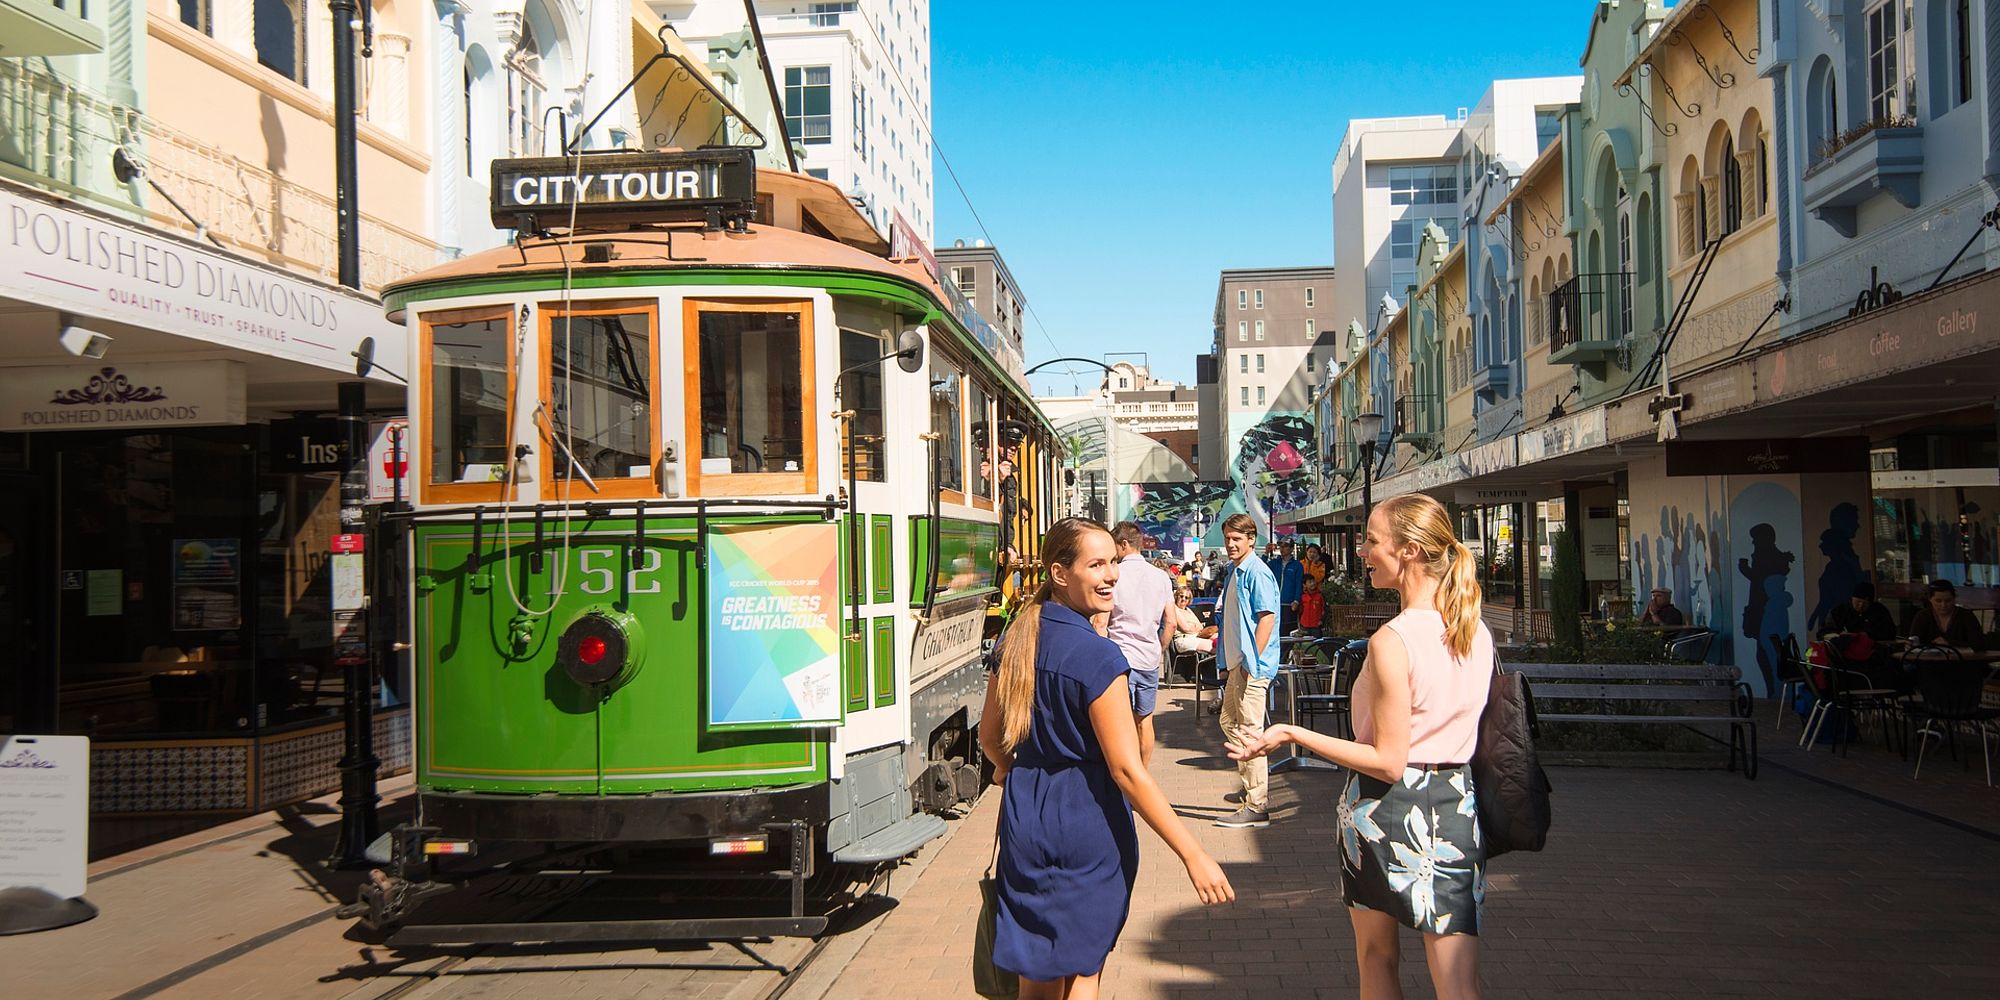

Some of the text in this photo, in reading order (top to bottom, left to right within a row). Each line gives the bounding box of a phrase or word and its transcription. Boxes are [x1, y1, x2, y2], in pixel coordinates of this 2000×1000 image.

[513, 174, 595, 206] CITY
[599, 170, 700, 202] TOUR
[11, 204, 338, 331] POLISHED DIAMONDS
[109, 288, 287, 343] QUALITY TRUST SPARKLE
[1818, 310, 1977, 370] Food Coffee Gallery
[23, 406, 198, 425] POLISHED DIAMONDS
[301, 436, 340, 464] Ins
[542, 549, 661, 594] 152
[721, 595, 822, 614] GREATNESS
[722, 613, 828, 631] IS CONTAGIOUS
